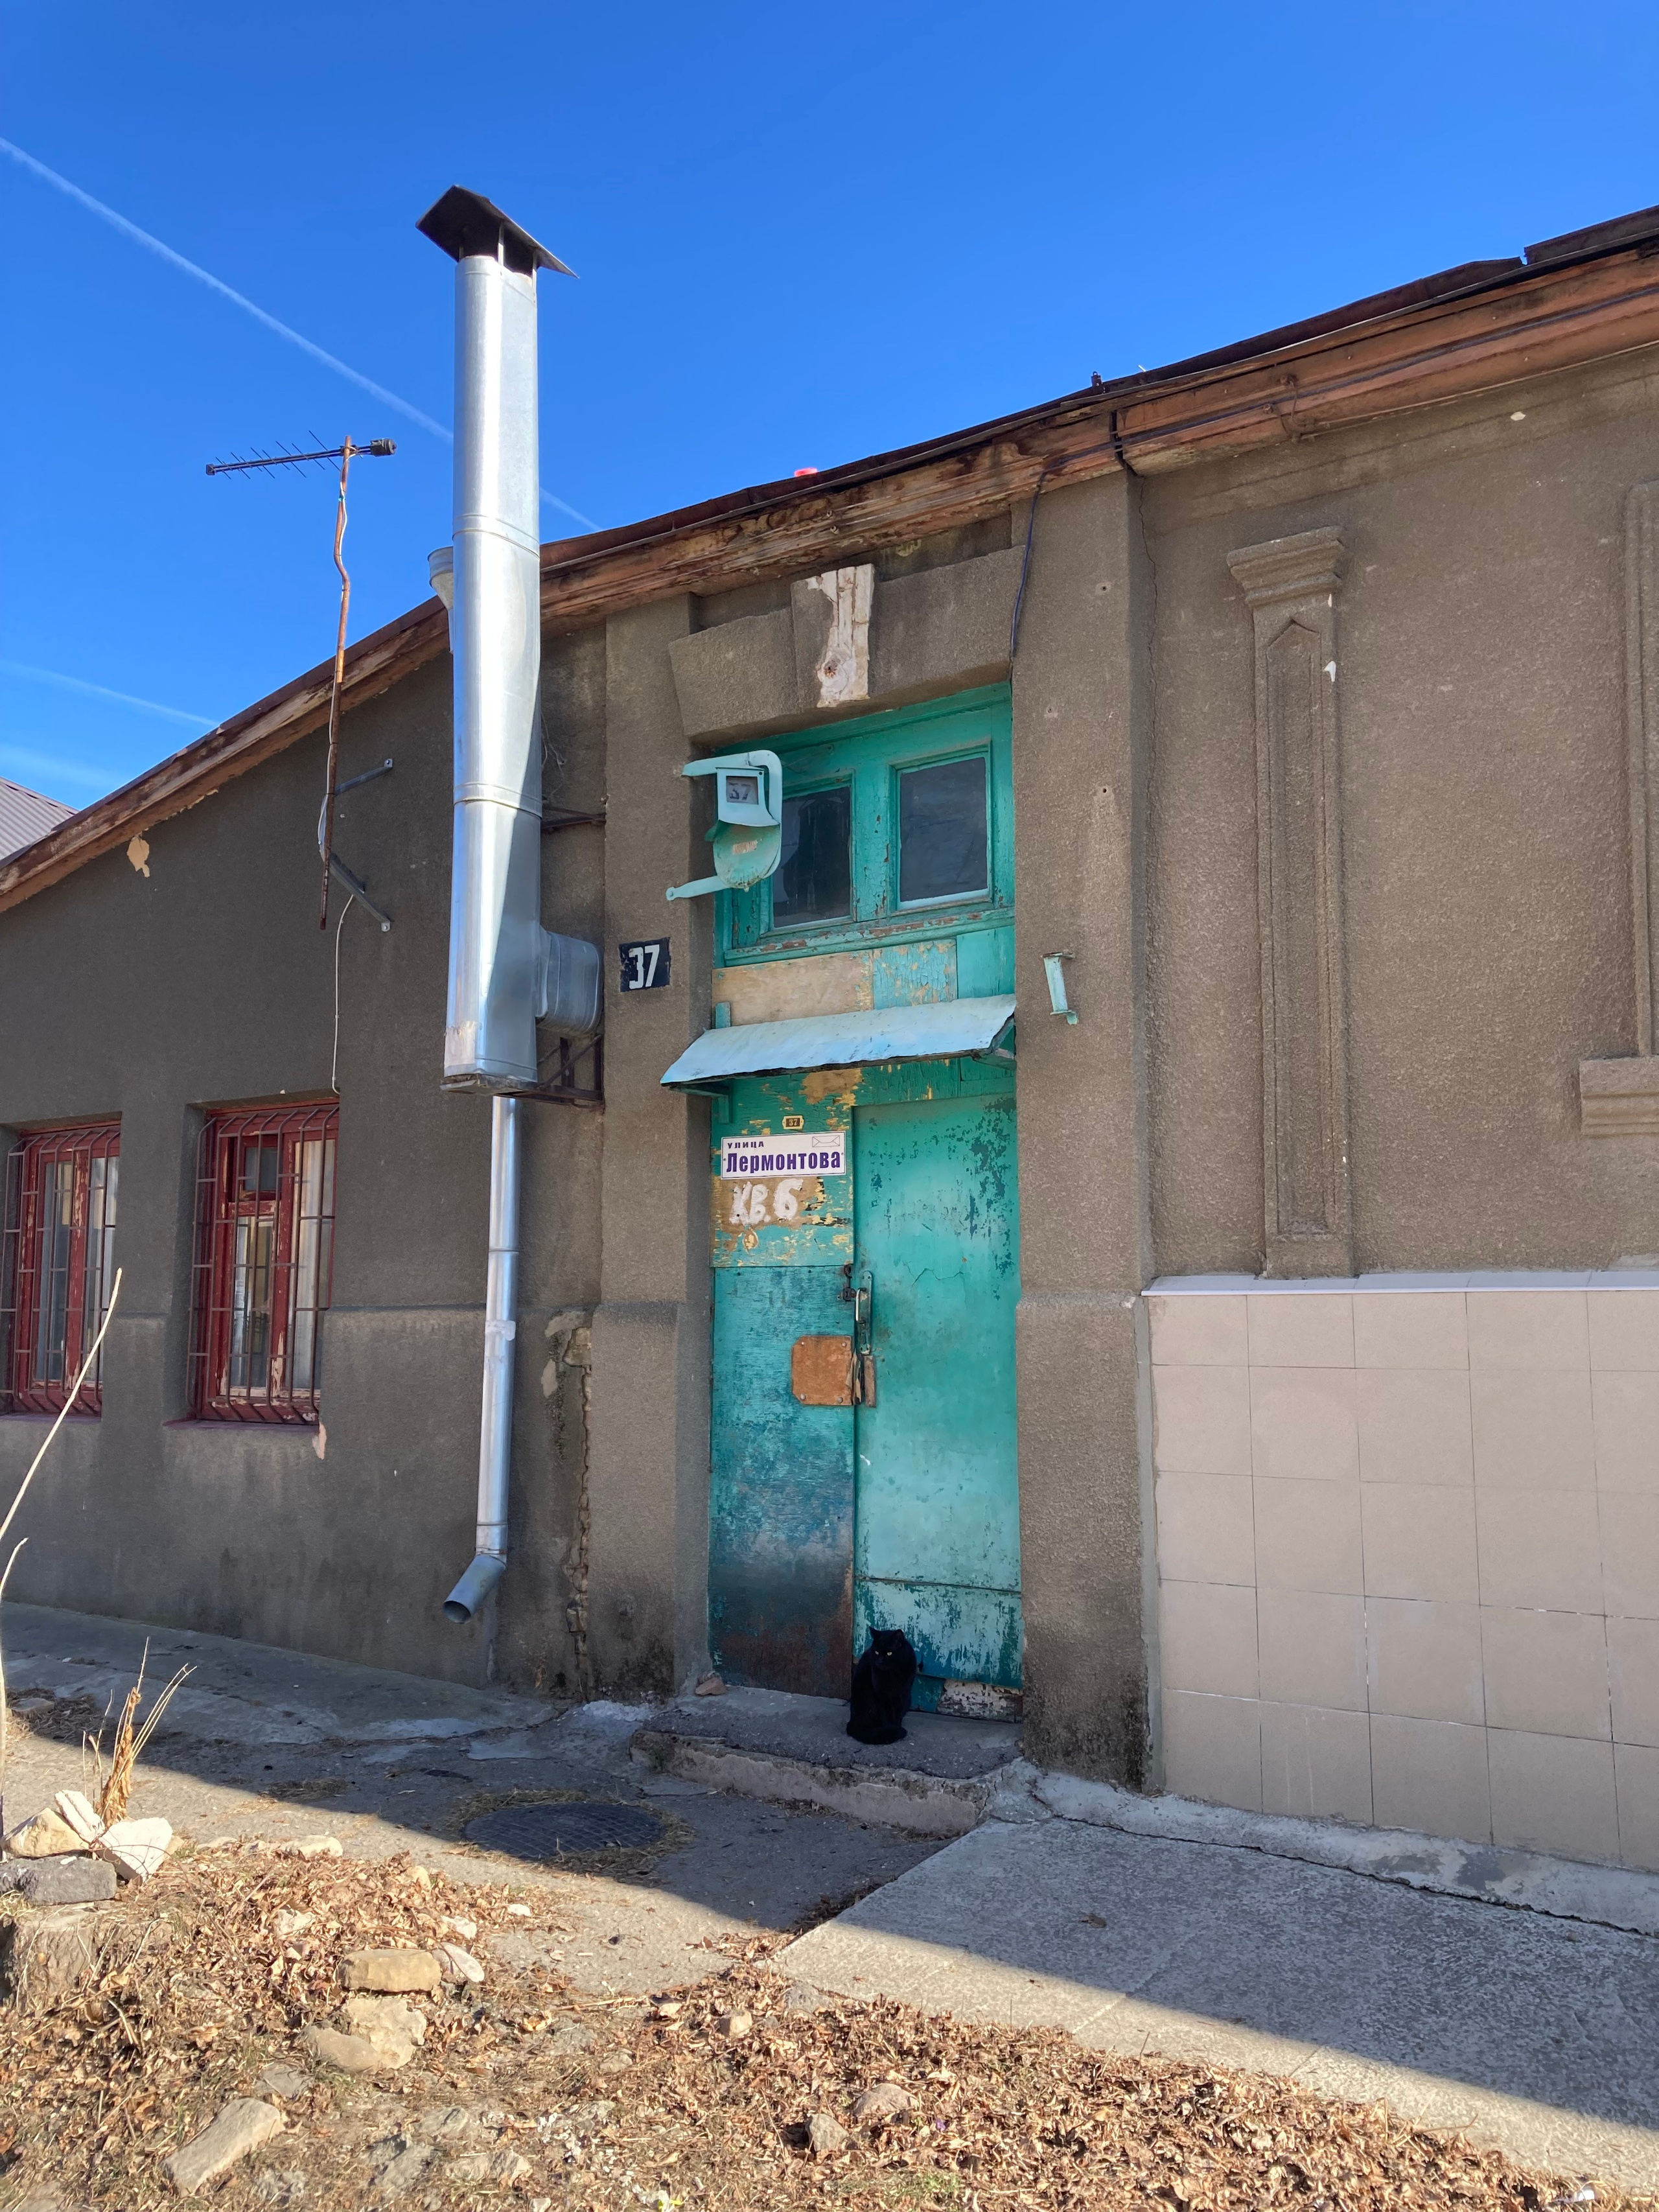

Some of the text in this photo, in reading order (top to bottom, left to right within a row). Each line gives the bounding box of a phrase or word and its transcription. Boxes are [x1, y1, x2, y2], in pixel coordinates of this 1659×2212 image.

[629, 944, 660, 990] 37
[789, 1118, 798, 1126] 37
[726, 1151, 841, 1174] Лермонтова
[773, 1178, 803, 1220] 6
